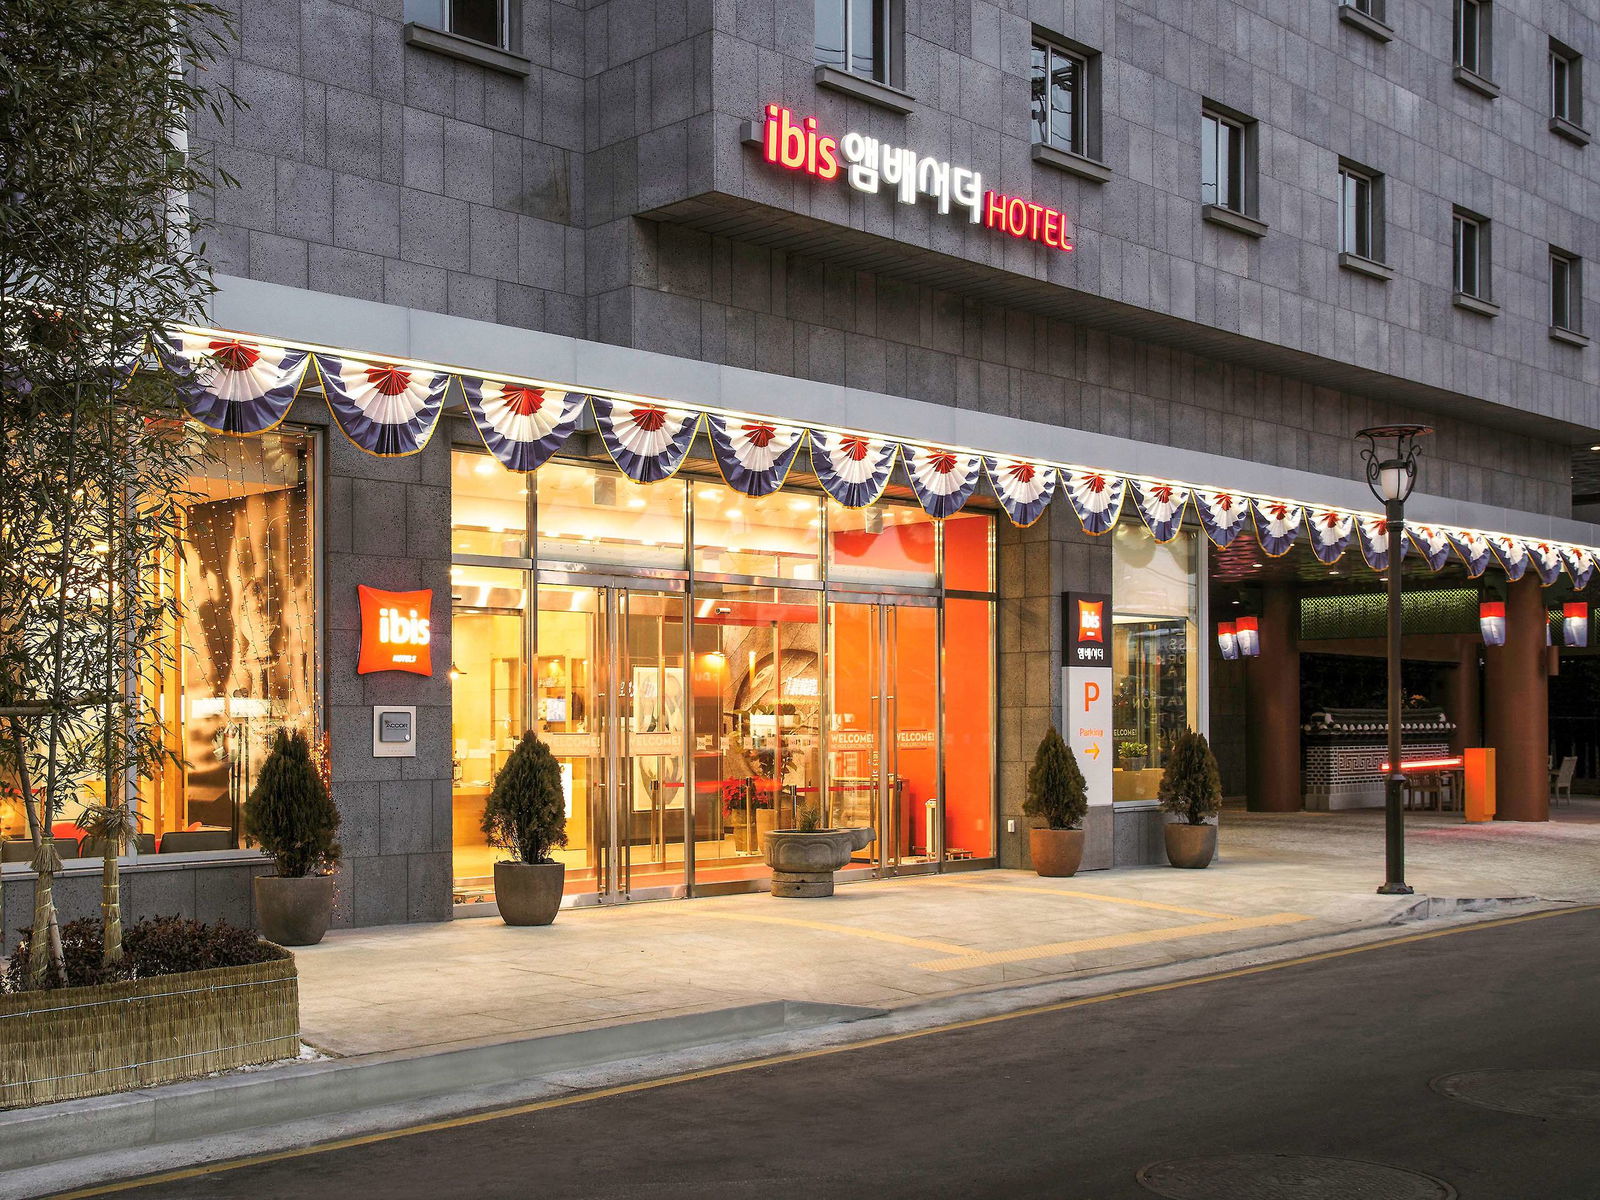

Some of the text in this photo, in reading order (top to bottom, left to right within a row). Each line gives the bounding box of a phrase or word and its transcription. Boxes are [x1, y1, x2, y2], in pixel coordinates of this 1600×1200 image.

[764, 104, 1074, 252] ibis 앰배서더 HOTEL
[379, 607, 431, 645] ibis
[1082, 611, 1101, 628] ibis
[1084, 681, 1100, 712] P
[831, 733, 874, 743] WELCOME!
[1080, 728, 1104, 738] Parking
